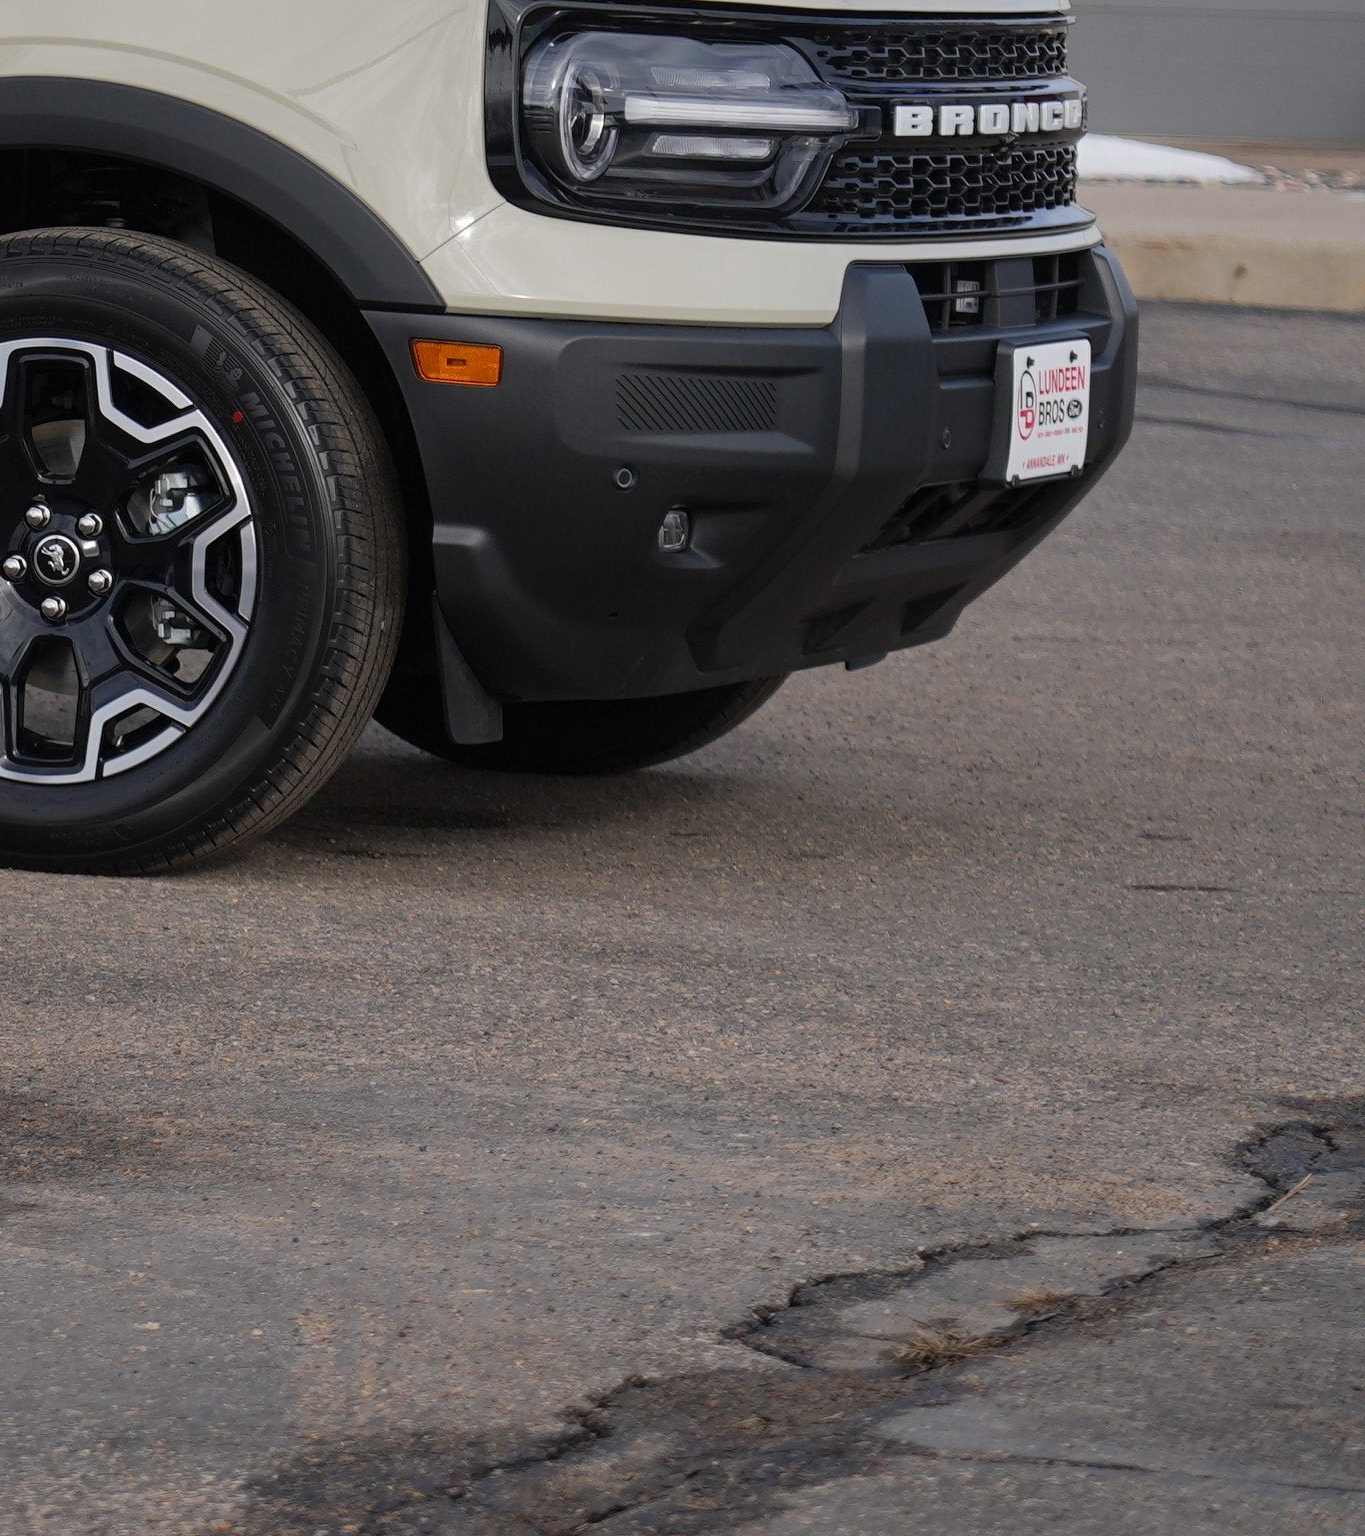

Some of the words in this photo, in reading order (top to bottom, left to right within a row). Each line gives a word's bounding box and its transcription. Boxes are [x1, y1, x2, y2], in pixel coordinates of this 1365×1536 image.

[893, 99, 1082, 137] BRONCO
[1038, 366, 1086, 395] LUNDEEN
[1038, 399, 1065, 426] BROS
[242, 390, 312, 560] MICHELIN
